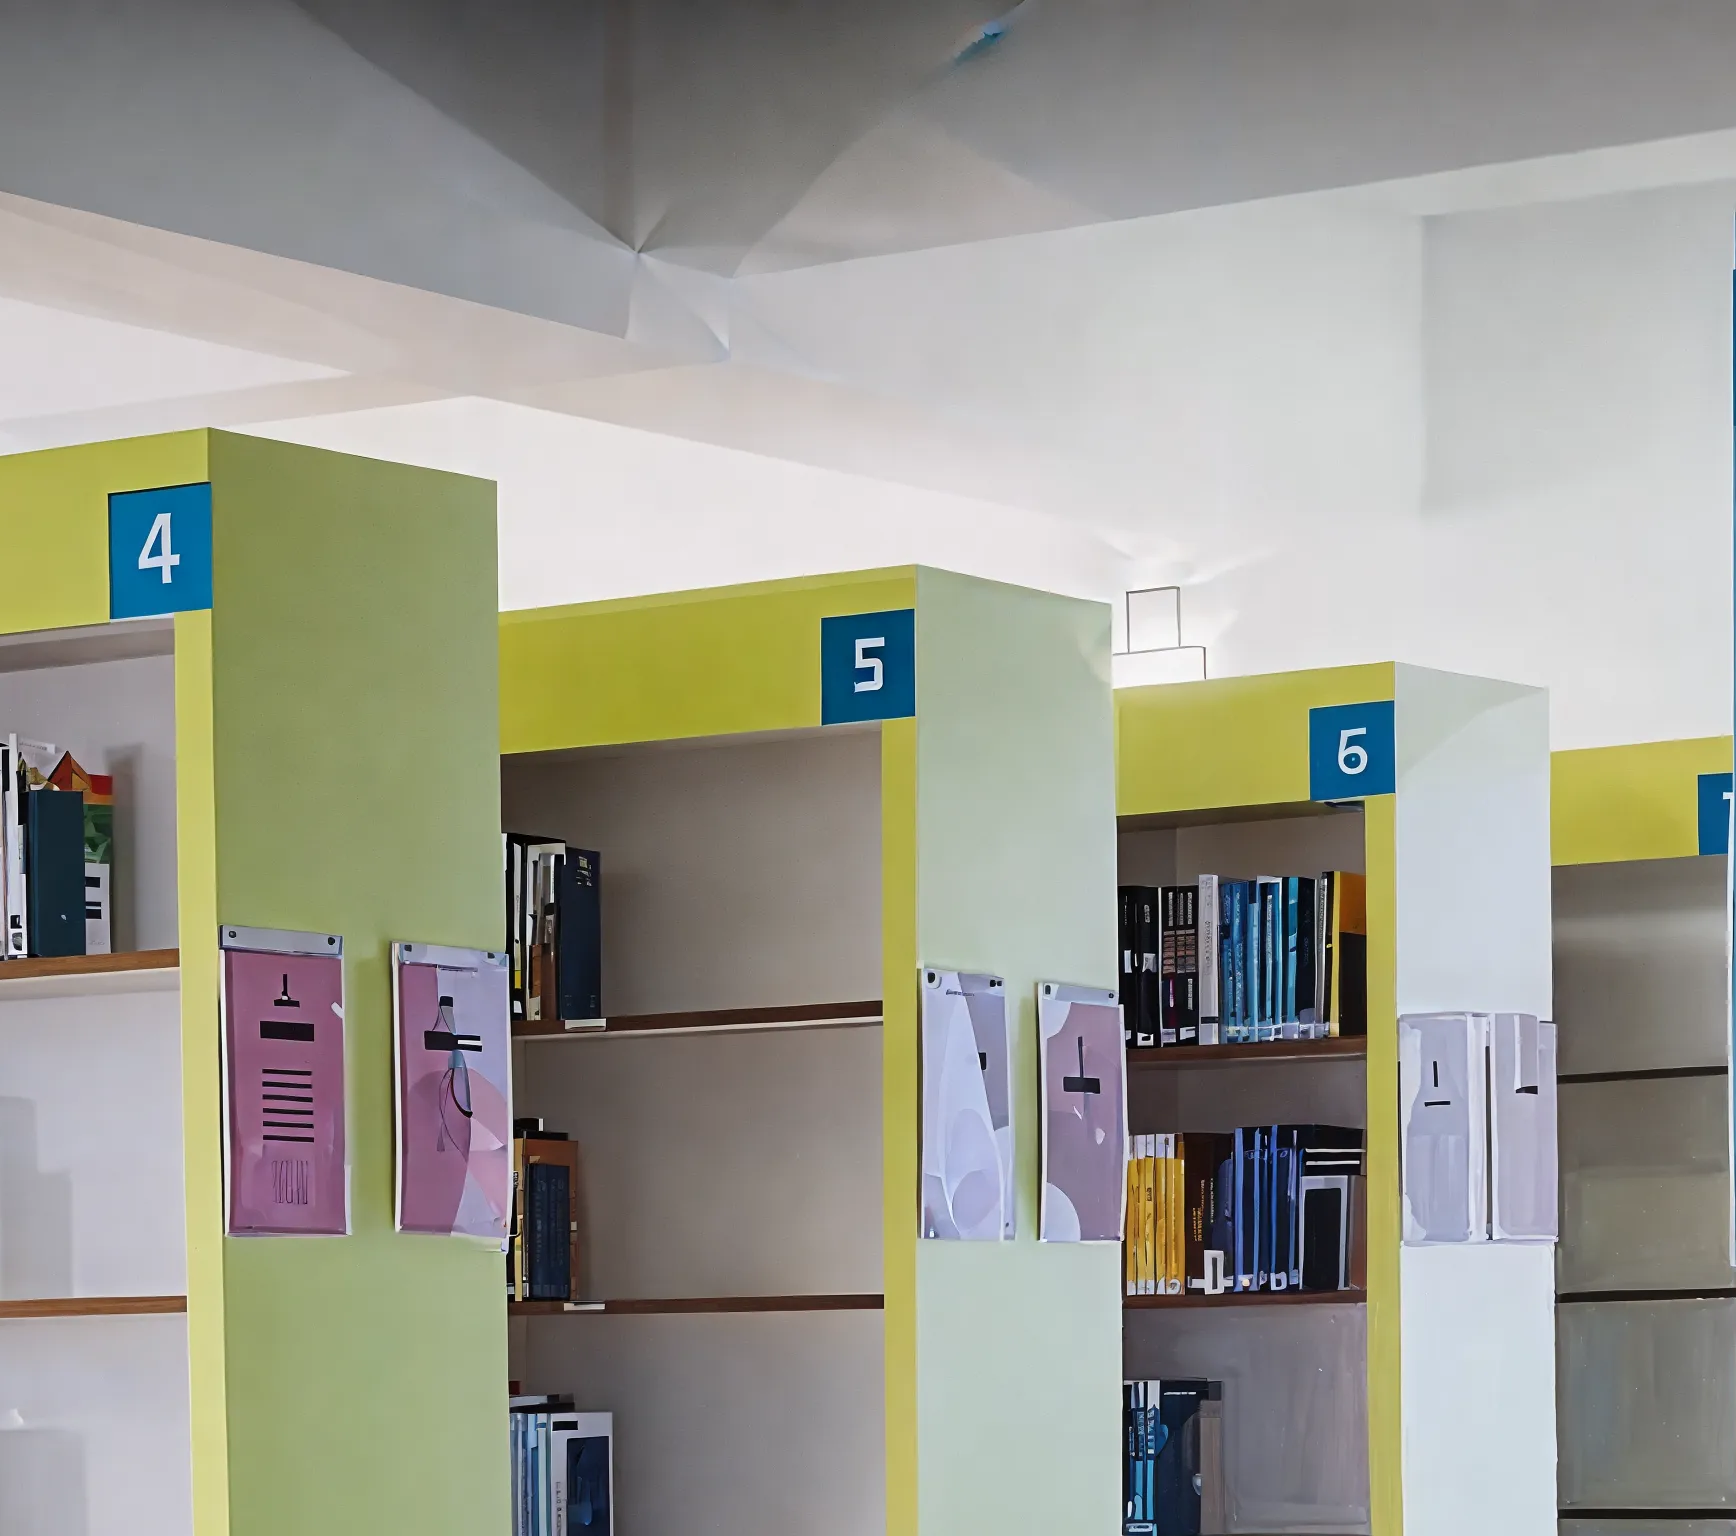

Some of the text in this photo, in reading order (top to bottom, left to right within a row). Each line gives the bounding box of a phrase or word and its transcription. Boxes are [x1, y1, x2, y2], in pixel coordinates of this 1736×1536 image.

[138, 512, 181, 584] 4
[853, 636, 885, 693] 5
[1337, 726, 1368, 775] 6
